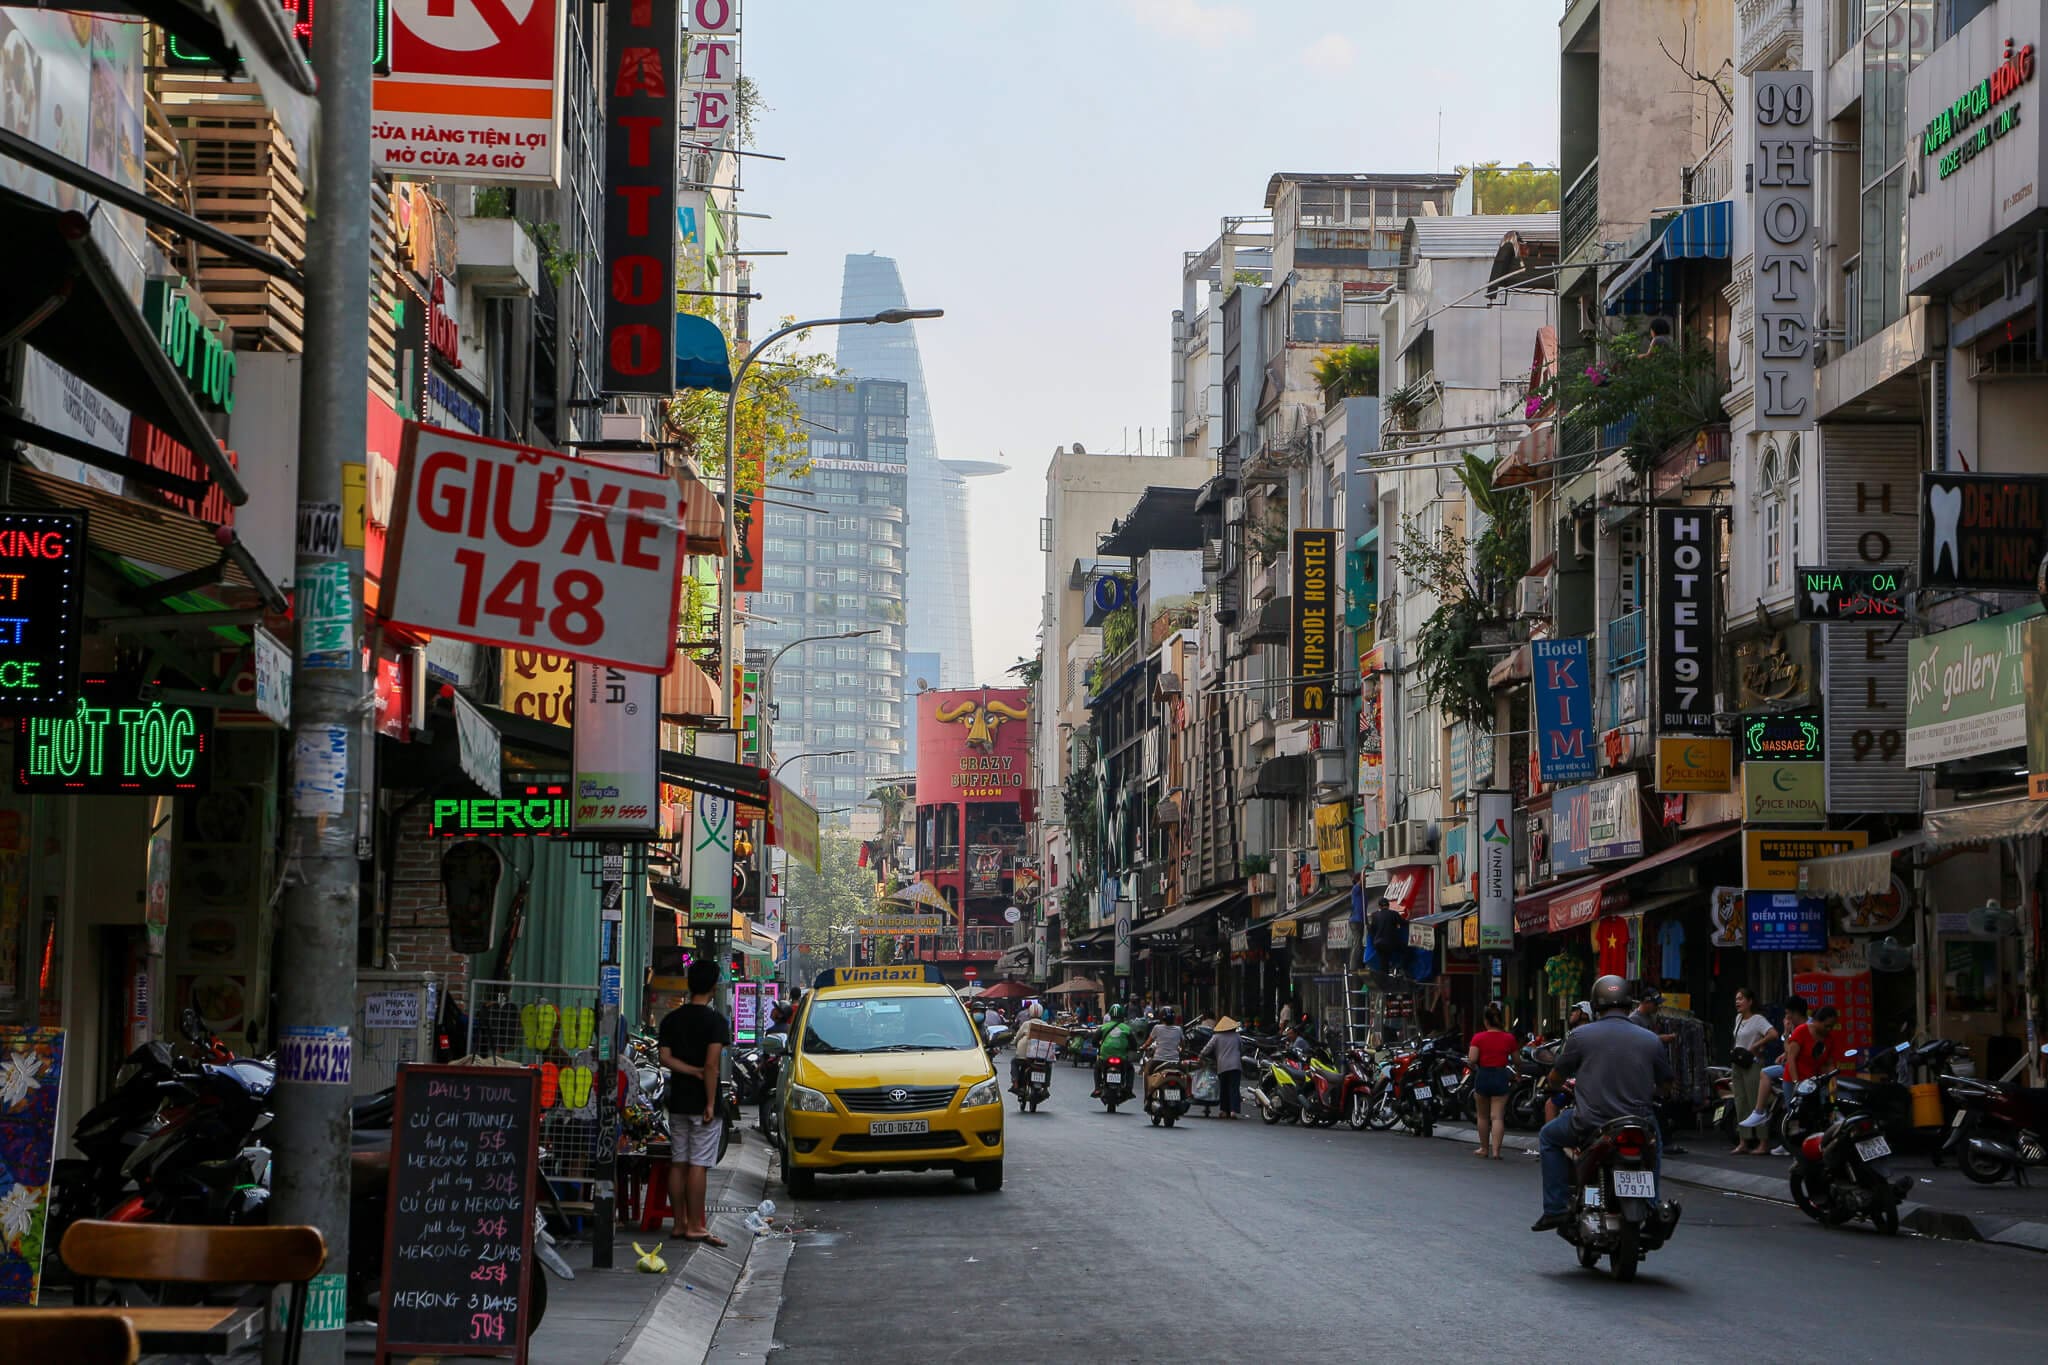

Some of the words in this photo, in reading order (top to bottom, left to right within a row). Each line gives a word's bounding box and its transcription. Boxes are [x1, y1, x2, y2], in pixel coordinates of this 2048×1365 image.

[1757, 83, 1813, 126] 99
[411, 124, 465, 144] HÀNG
[468, 127, 514, 149] TIỆN
[515, 132, 547, 153] LỢI
[1924, 107, 1952, 155] NHA
[1939, 151, 1960, 180] ROSE
[1992, 103, 2021, 139] CLINIC
[385, 147, 417, 163] MỞ
[419, 148, 462, 165] CỬA
[465, 152, 488, 167] 24
[492, 152, 527, 169] GIỜ
[1758, 140, 1811, 418] HOTEL
[835, 460, 874, 472] THANH
[1963, 482, 2043, 529] DENTAL
[561, 476, 667, 572] XE
[1963, 534, 2038, 579] CLINIC
[1303, 538, 1326, 602] HOSTEL
[1673, 516, 1700, 654] HOTEL
[1807, 574, 1843, 592] NHA
[453, 547, 605, 646] 148
[1856, 482, 1892, 709] HOEL
[1303, 608, 1326, 677] FLIPSIDE
[1537, 640, 1583, 657] Hotel
[1675, 658, 1700, 711] 97
[1908, 645, 1940, 716] ART
[1942, 643, 2003, 712] gallery
[1546, 658, 1586, 760] KIM
[1665, 713, 1683, 725] BUI
[1687, 712, 1712, 726] VIEN
[1762, 739, 1806, 752] MASSAGE
[1851, 728, 1900, 762] 99
[960, 756, 1012, 770] CRAZY
[1696, 767, 1727, 779] INDIA
[951, 773, 1022, 788] BUFFALO
[1755, 795, 1784, 816] SPICE
[1786, 799, 1818, 810] INDIA
[1552, 812, 1571, 845] Hotel
[1762, 842, 1814, 851] WESTERN
[1778, 848, 1814, 857] UNION
[1778, 911, 1798, 921] THU
[841, 966, 918, 983] Vinataxi
[428, 1080, 471, 1101] DAILY
[478, 1085, 517, 1103] TOUR
[462, 1111, 519, 1129] TUNNEL
[478, 1129, 507, 1151] 5$
[407, 1152, 468, 1169] MEKONG
[474, 1151, 517, 1169] DELTA
[455, 1171, 473, 1192] day
[480, 1170, 519, 1196] 30$
[1616, 1184, 1651, 1196] 179.71
[1619, 1173, 1648, 1184] 59-U1
[464, 1195, 521, 1213] MEKONG
[446, 1218, 466, 1240] day
[472, 1215, 508, 1240] 30$
[399, 1244, 472, 1260] MEKONG
[477, 1243, 496, 1261] 2
[494, 1244, 521, 1263] DAYS
[469, 1262, 508, 1287] 25$
[393, 1290, 461, 1310] MEKONG
[467, 1293, 479, 1310] 3
[483, 1293, 518, 1313] DAYS
[469, 1311, 507, 1342] 50$
